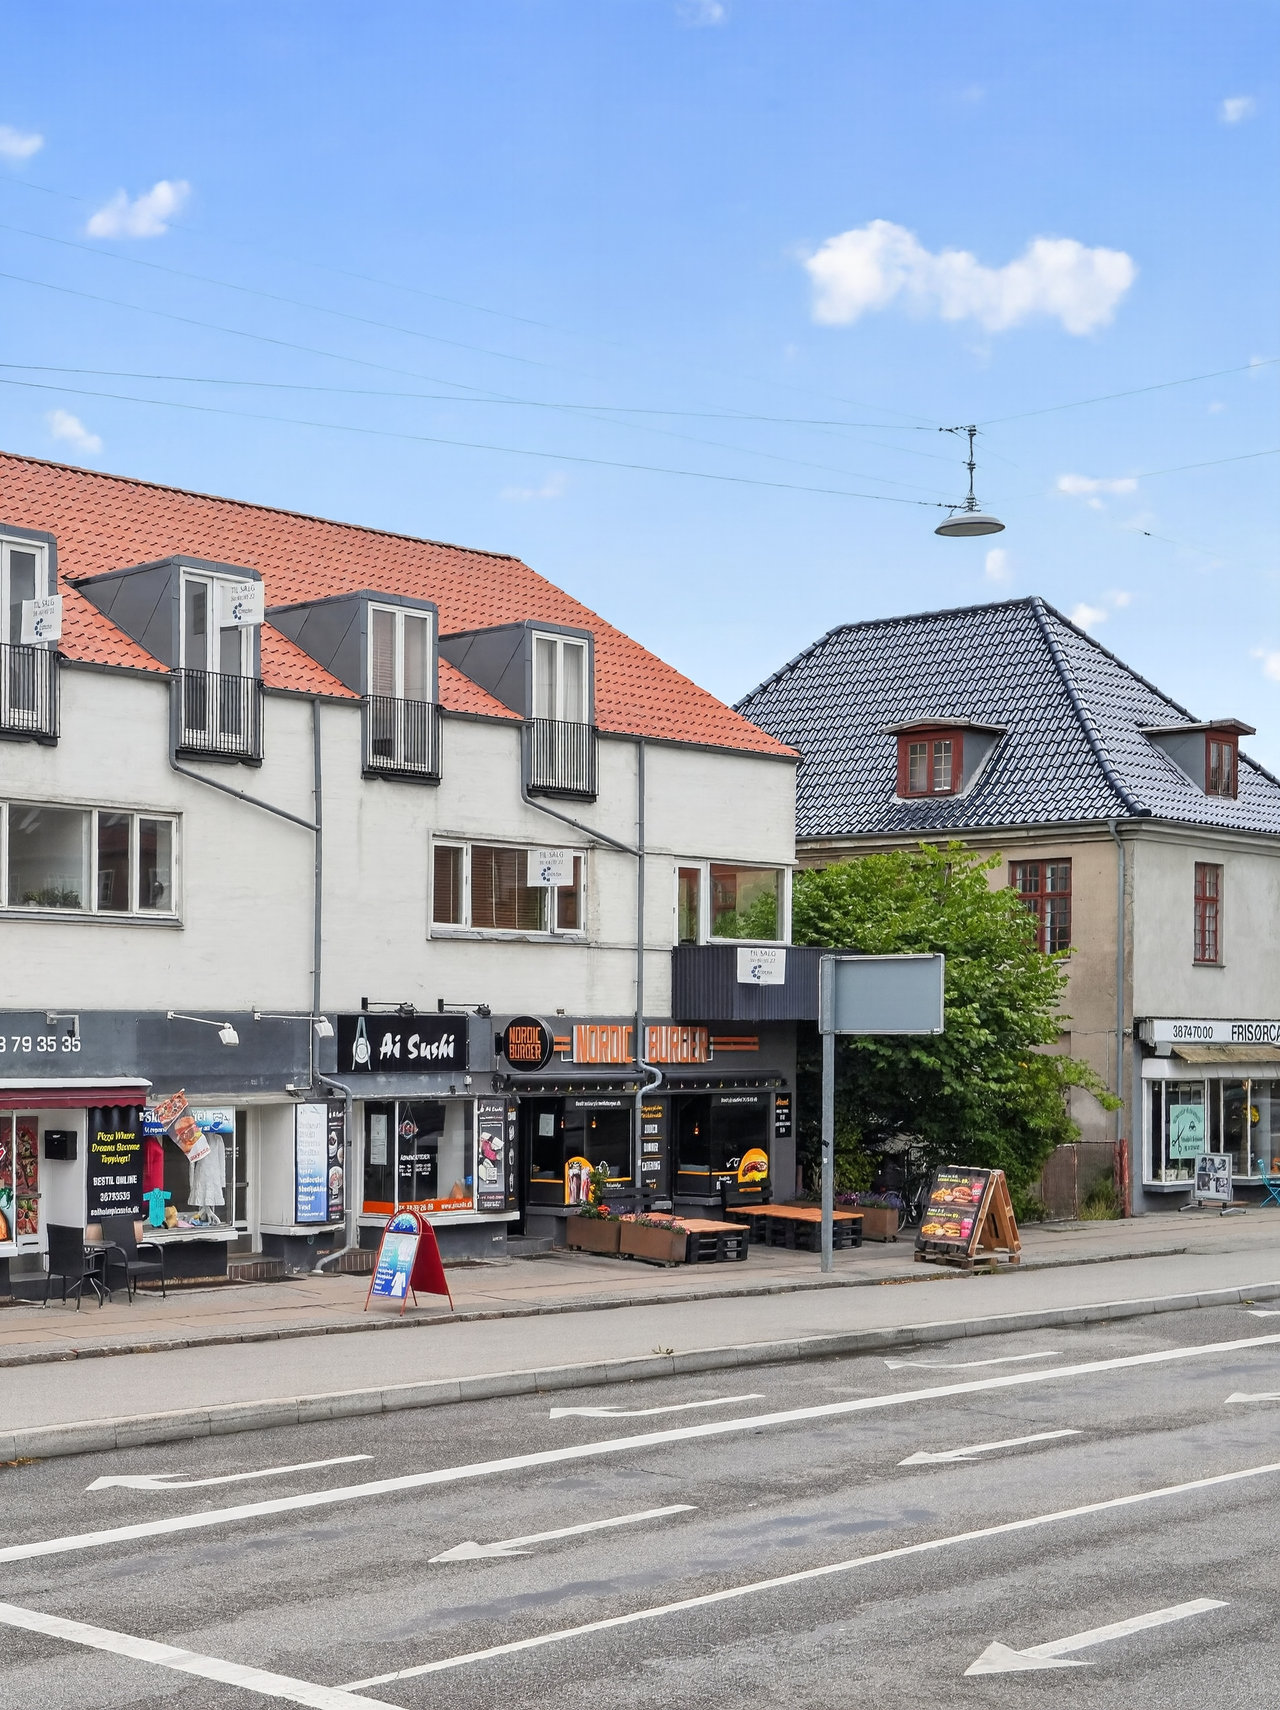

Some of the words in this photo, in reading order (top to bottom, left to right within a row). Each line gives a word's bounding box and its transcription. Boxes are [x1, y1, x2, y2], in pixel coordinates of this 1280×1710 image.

[509, 1026, 541, 1044] NORDIC
[1172, 1025, 1213, 1039] 38747000
[11, 1036, 32, 1053] 79
[36, 1036, 57, 1053] 35
[61, 1036, 81, 1053] 35
[379, 1032, 401, 1060] Ai
[407, 1033, 455, 1060] Sushi
[509, 1044, 541, 1059] BURGER
[573, 1025, 633, 1064] NORDIC
[645, 1026, 709, 1064] BURGER
